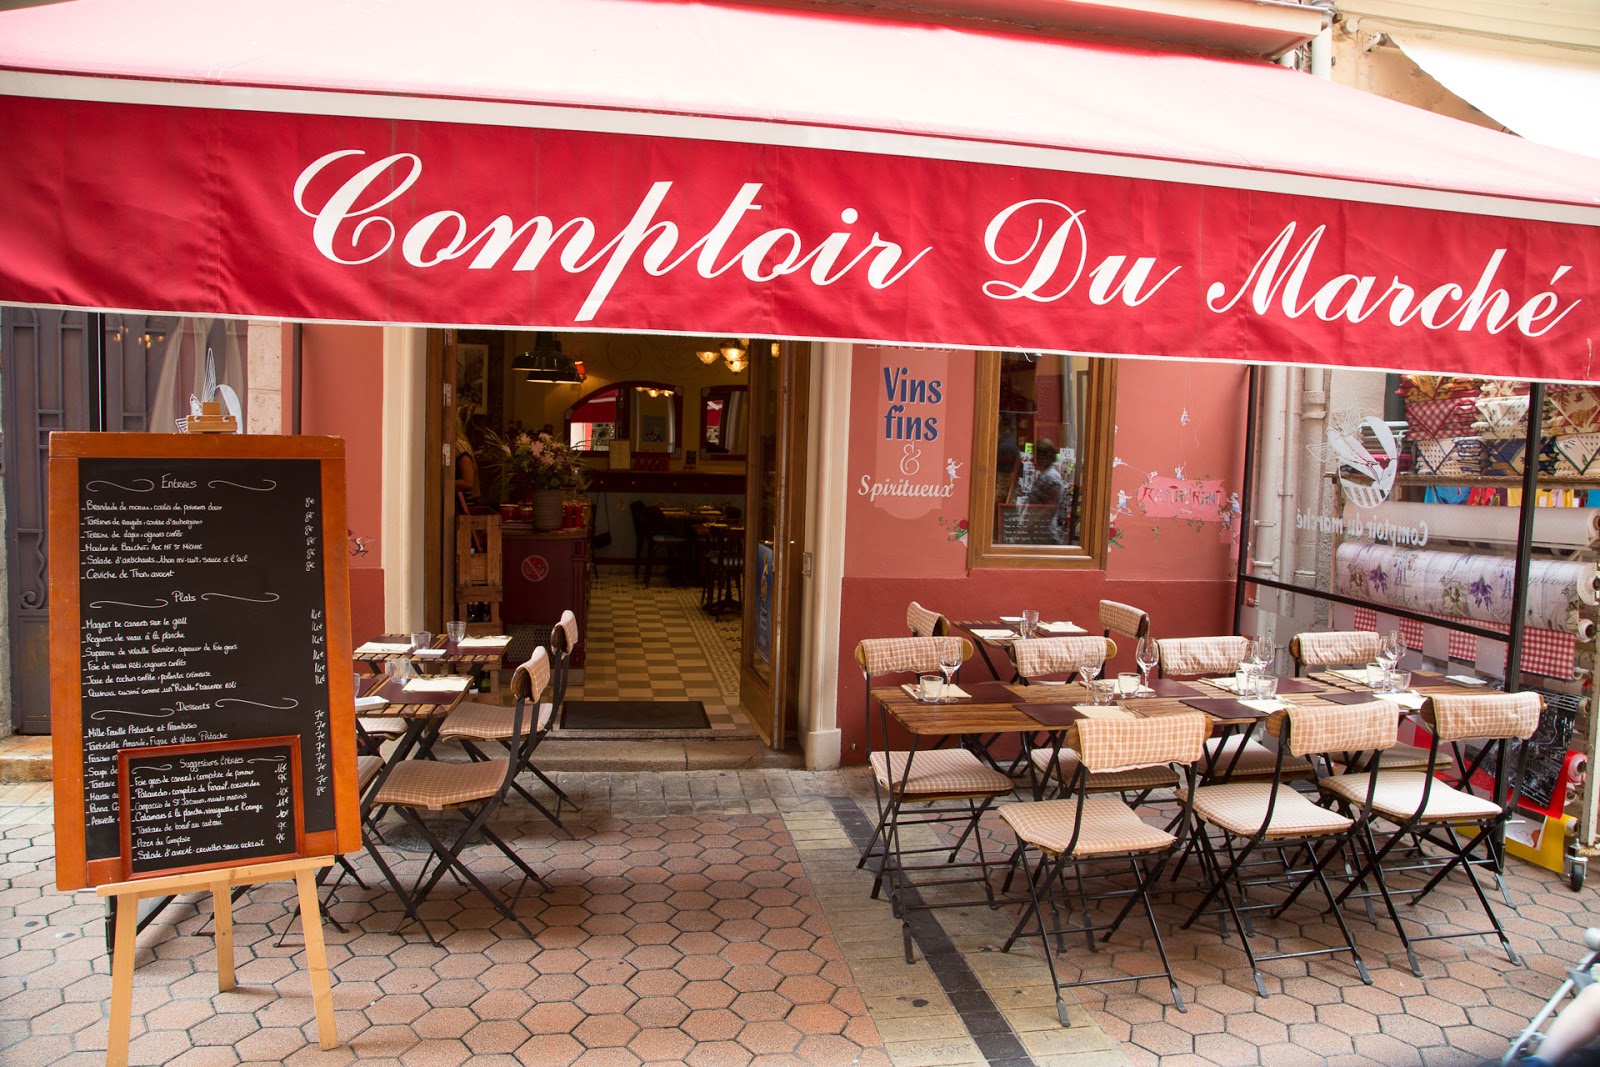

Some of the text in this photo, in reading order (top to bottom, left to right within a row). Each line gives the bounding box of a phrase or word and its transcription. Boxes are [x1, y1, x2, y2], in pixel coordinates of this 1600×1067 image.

[293, 149, 1582, 338] Comptoir Du Marché
[883, 367, 943, 405] Vins
[884, 405, 939, 441] fins
[900, 441, 921, 475] &
[858, 474, 954, 502] Spiritueux
[86, 500, 118, 510] Brandade
[120, 502, 127, 510] de
[87, 555, 112, 564] Salade
[86, 568, 117, 579] Ceviche
[119, 569, 128, 578] de
[171, 590, 196, 602] Plats
[115, 633, 124, 641] de
[152, 631, 160, 640] la
[118, 646, 126, 656] de
[204, 643, 210, 651] de
[87, 660, 100, 671] Foie
[101, 662, 110, 670] de
[105, 675, 114, 683] de
[88, 689, 116, 698] Quinoa
[176, 702, 210, 712] Desserts
[315, 710, 325, 720] 7€
[128, 724, 154, 734] Pistache
[157, 723, 166, 732] et
[315, 721, 326, 731] 7€
[86, 741, 120, 751] Tartelette
[171, 735, 178, 744] et
[180, 735, 196, 745] glace
[198, 731, 228, 740] Pistache
[315, 731, 325, 741] 7€
[316, 742, 326, 752] 7€
[316, 752, 326, 763] 7€
[180, 758, 218, 772] Suggestions
[88, 767, 108, 778] Soupe
[135, 776, 147, 786] Foie
[226, 769, 234, 777] de
[89, 780, 116, 789] Tartare
[198, 784, 206, 792] de
[89, 802, 109, 813] Panna
[165, 799, 171, 807] de
[174, 810, 181, 818] la
[136, 826, 162, 835] Tartare
[156, 837, 164, 845] du
[165, 836, 191, 847] Comptoir
[137, 850, 162, 861] Salade
